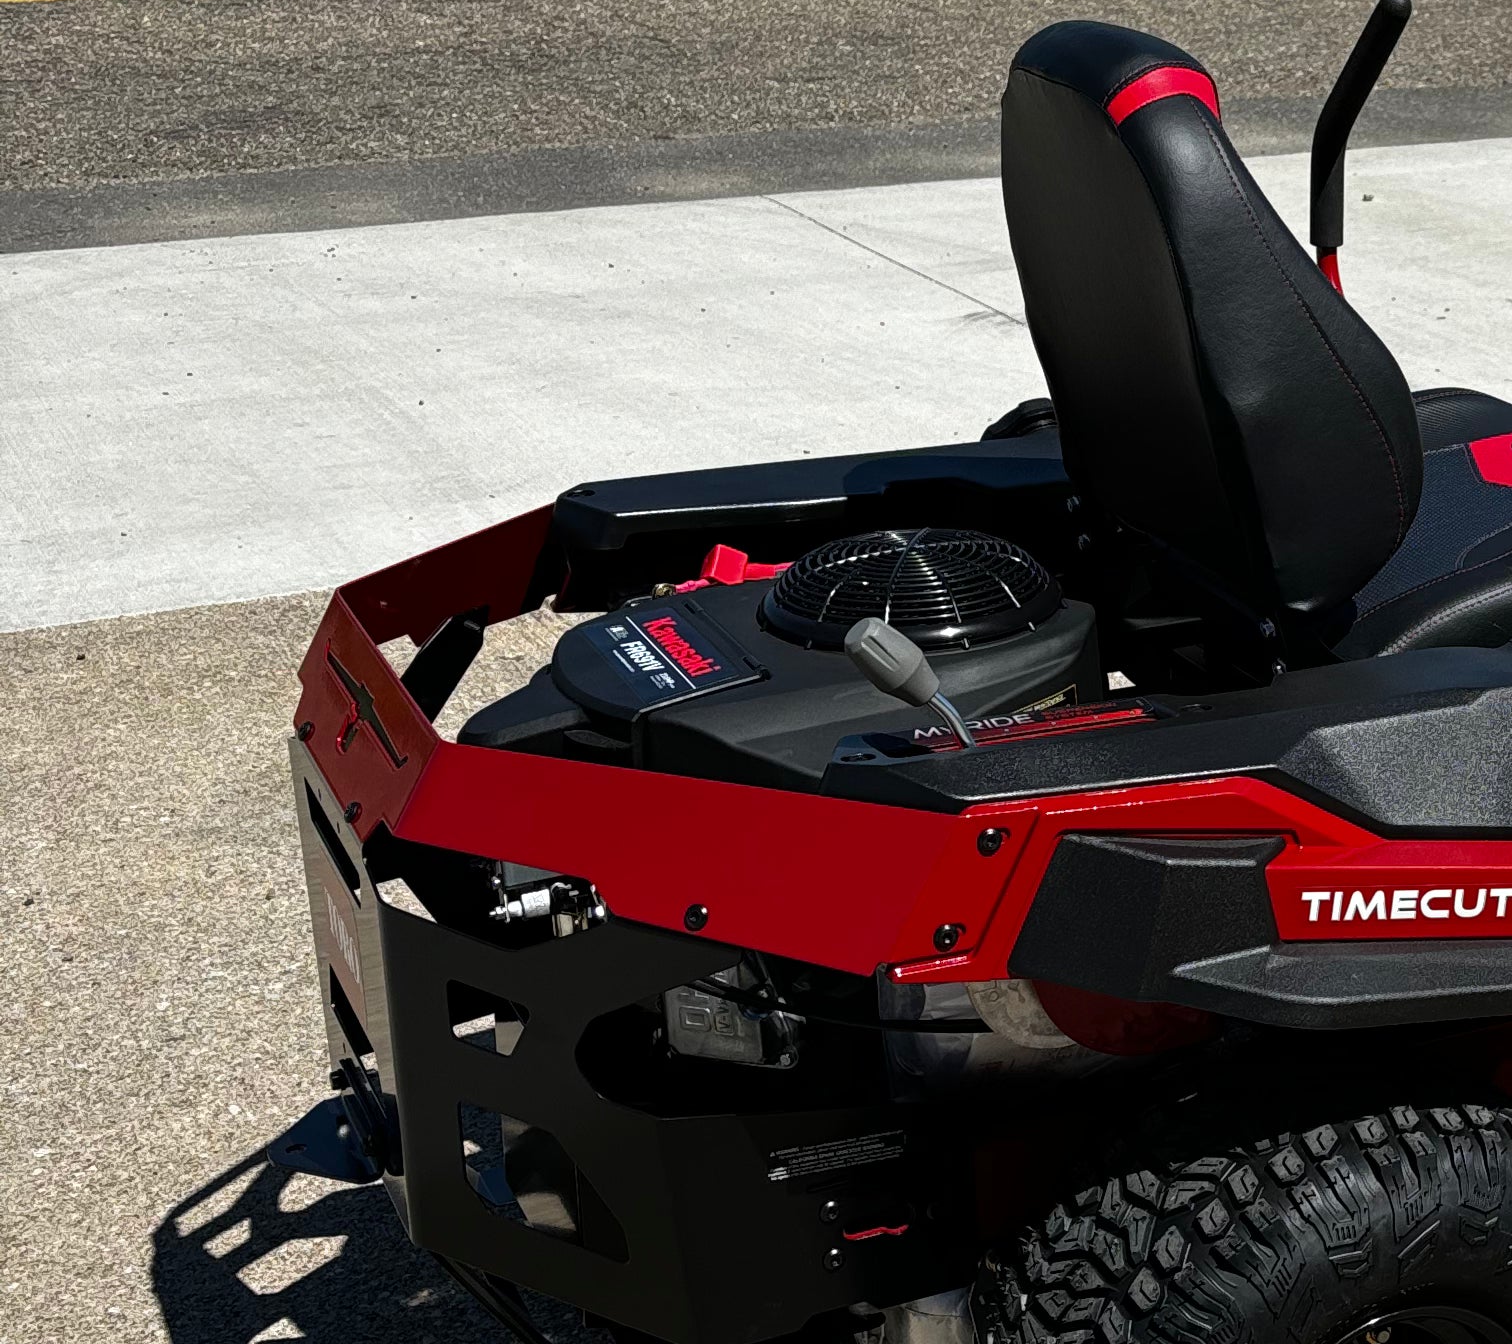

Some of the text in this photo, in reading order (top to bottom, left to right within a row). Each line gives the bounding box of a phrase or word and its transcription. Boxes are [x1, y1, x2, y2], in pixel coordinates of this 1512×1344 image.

[620, 640, 665, 672] FR691V
[641, 615, 721, 678] Kawasaki
[323, 886, 360, 984] TORO
